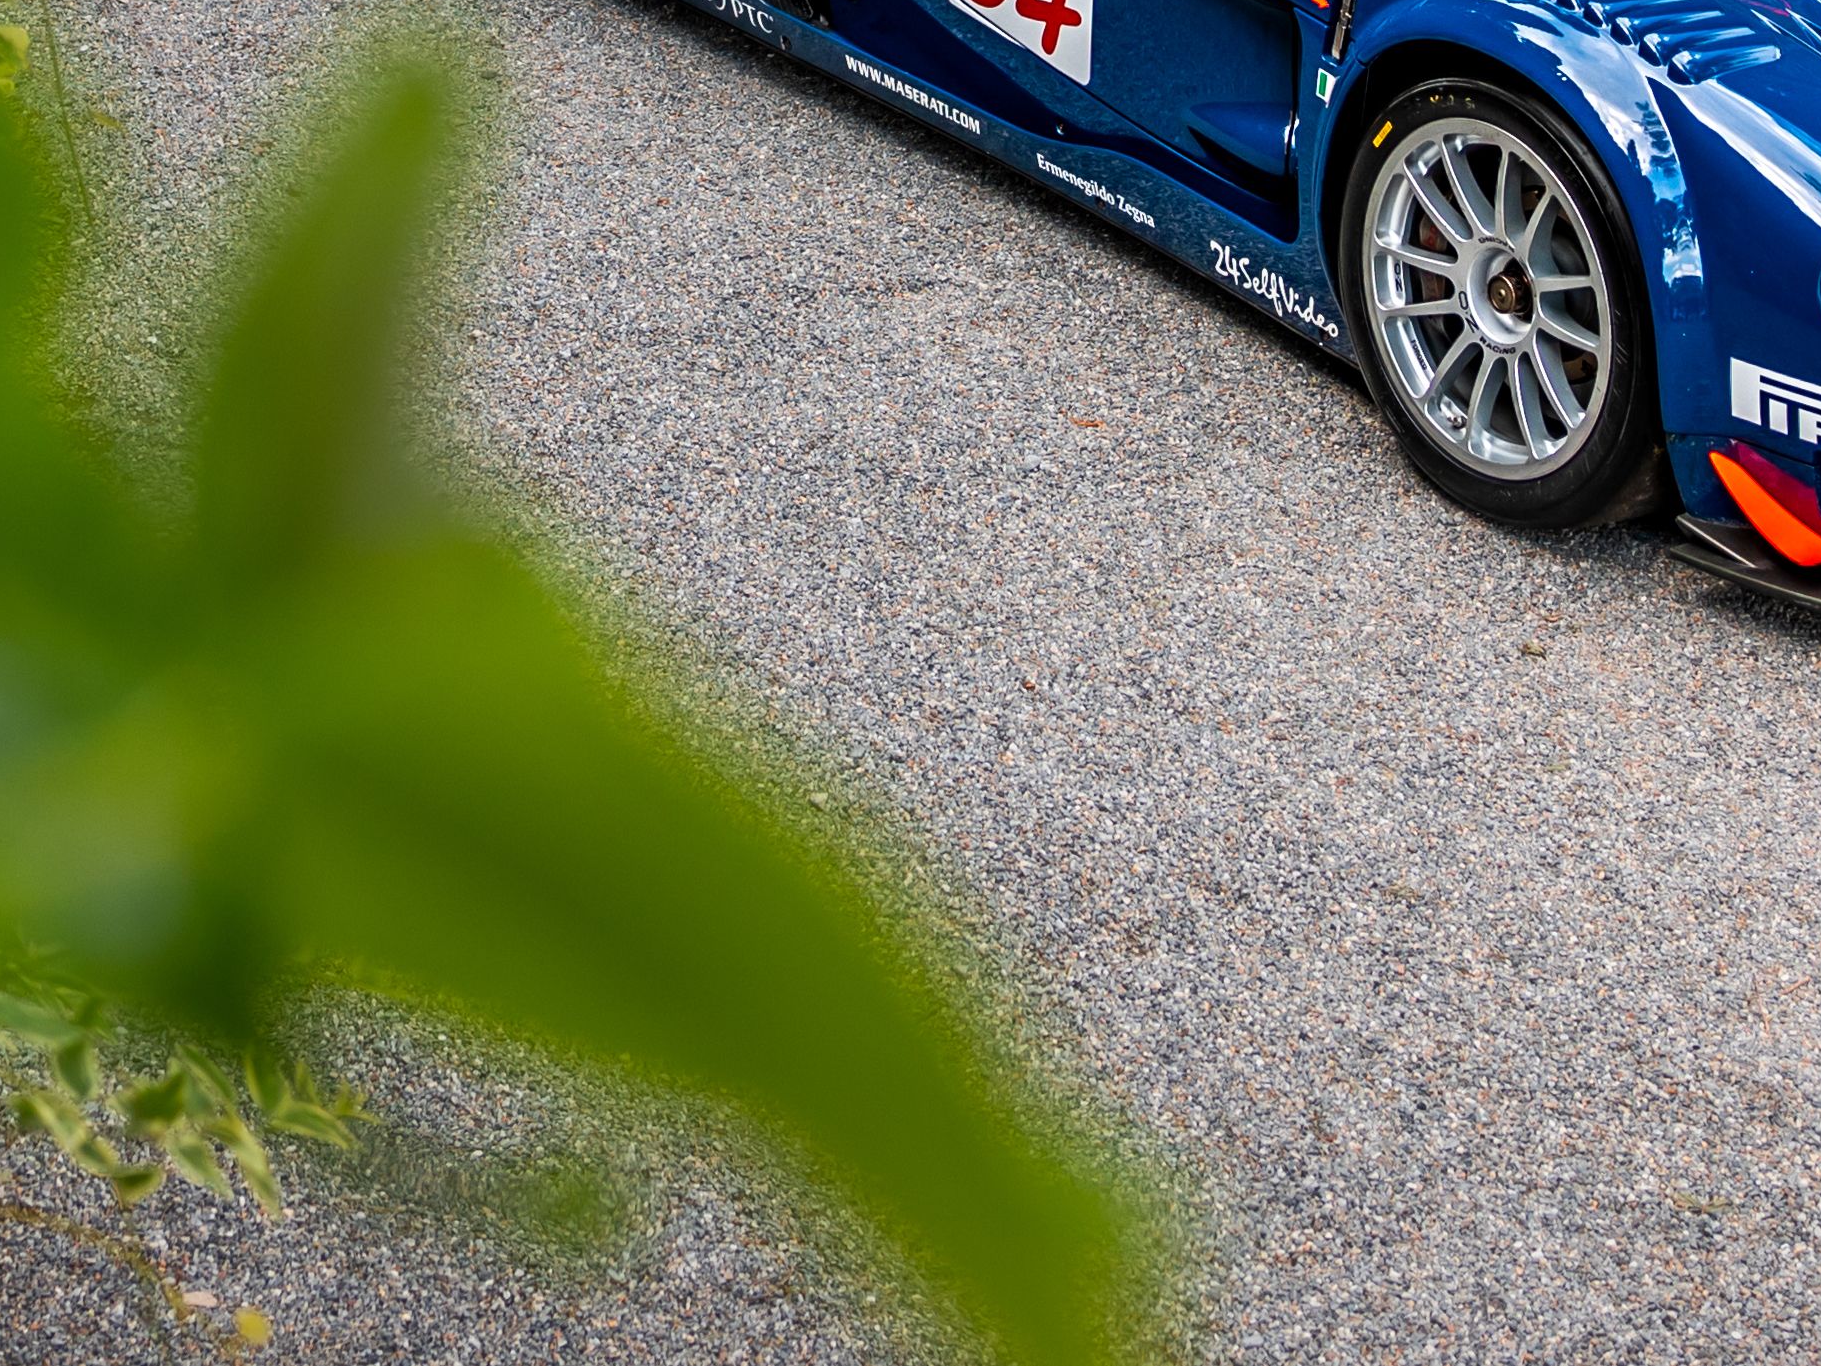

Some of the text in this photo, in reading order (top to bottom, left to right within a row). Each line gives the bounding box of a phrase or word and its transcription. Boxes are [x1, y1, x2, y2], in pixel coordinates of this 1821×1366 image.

[845, 54, 981, 135] WWW.MASERATI.COM
[1036, 153, 1156, 229] Ermenegildo Zegna
